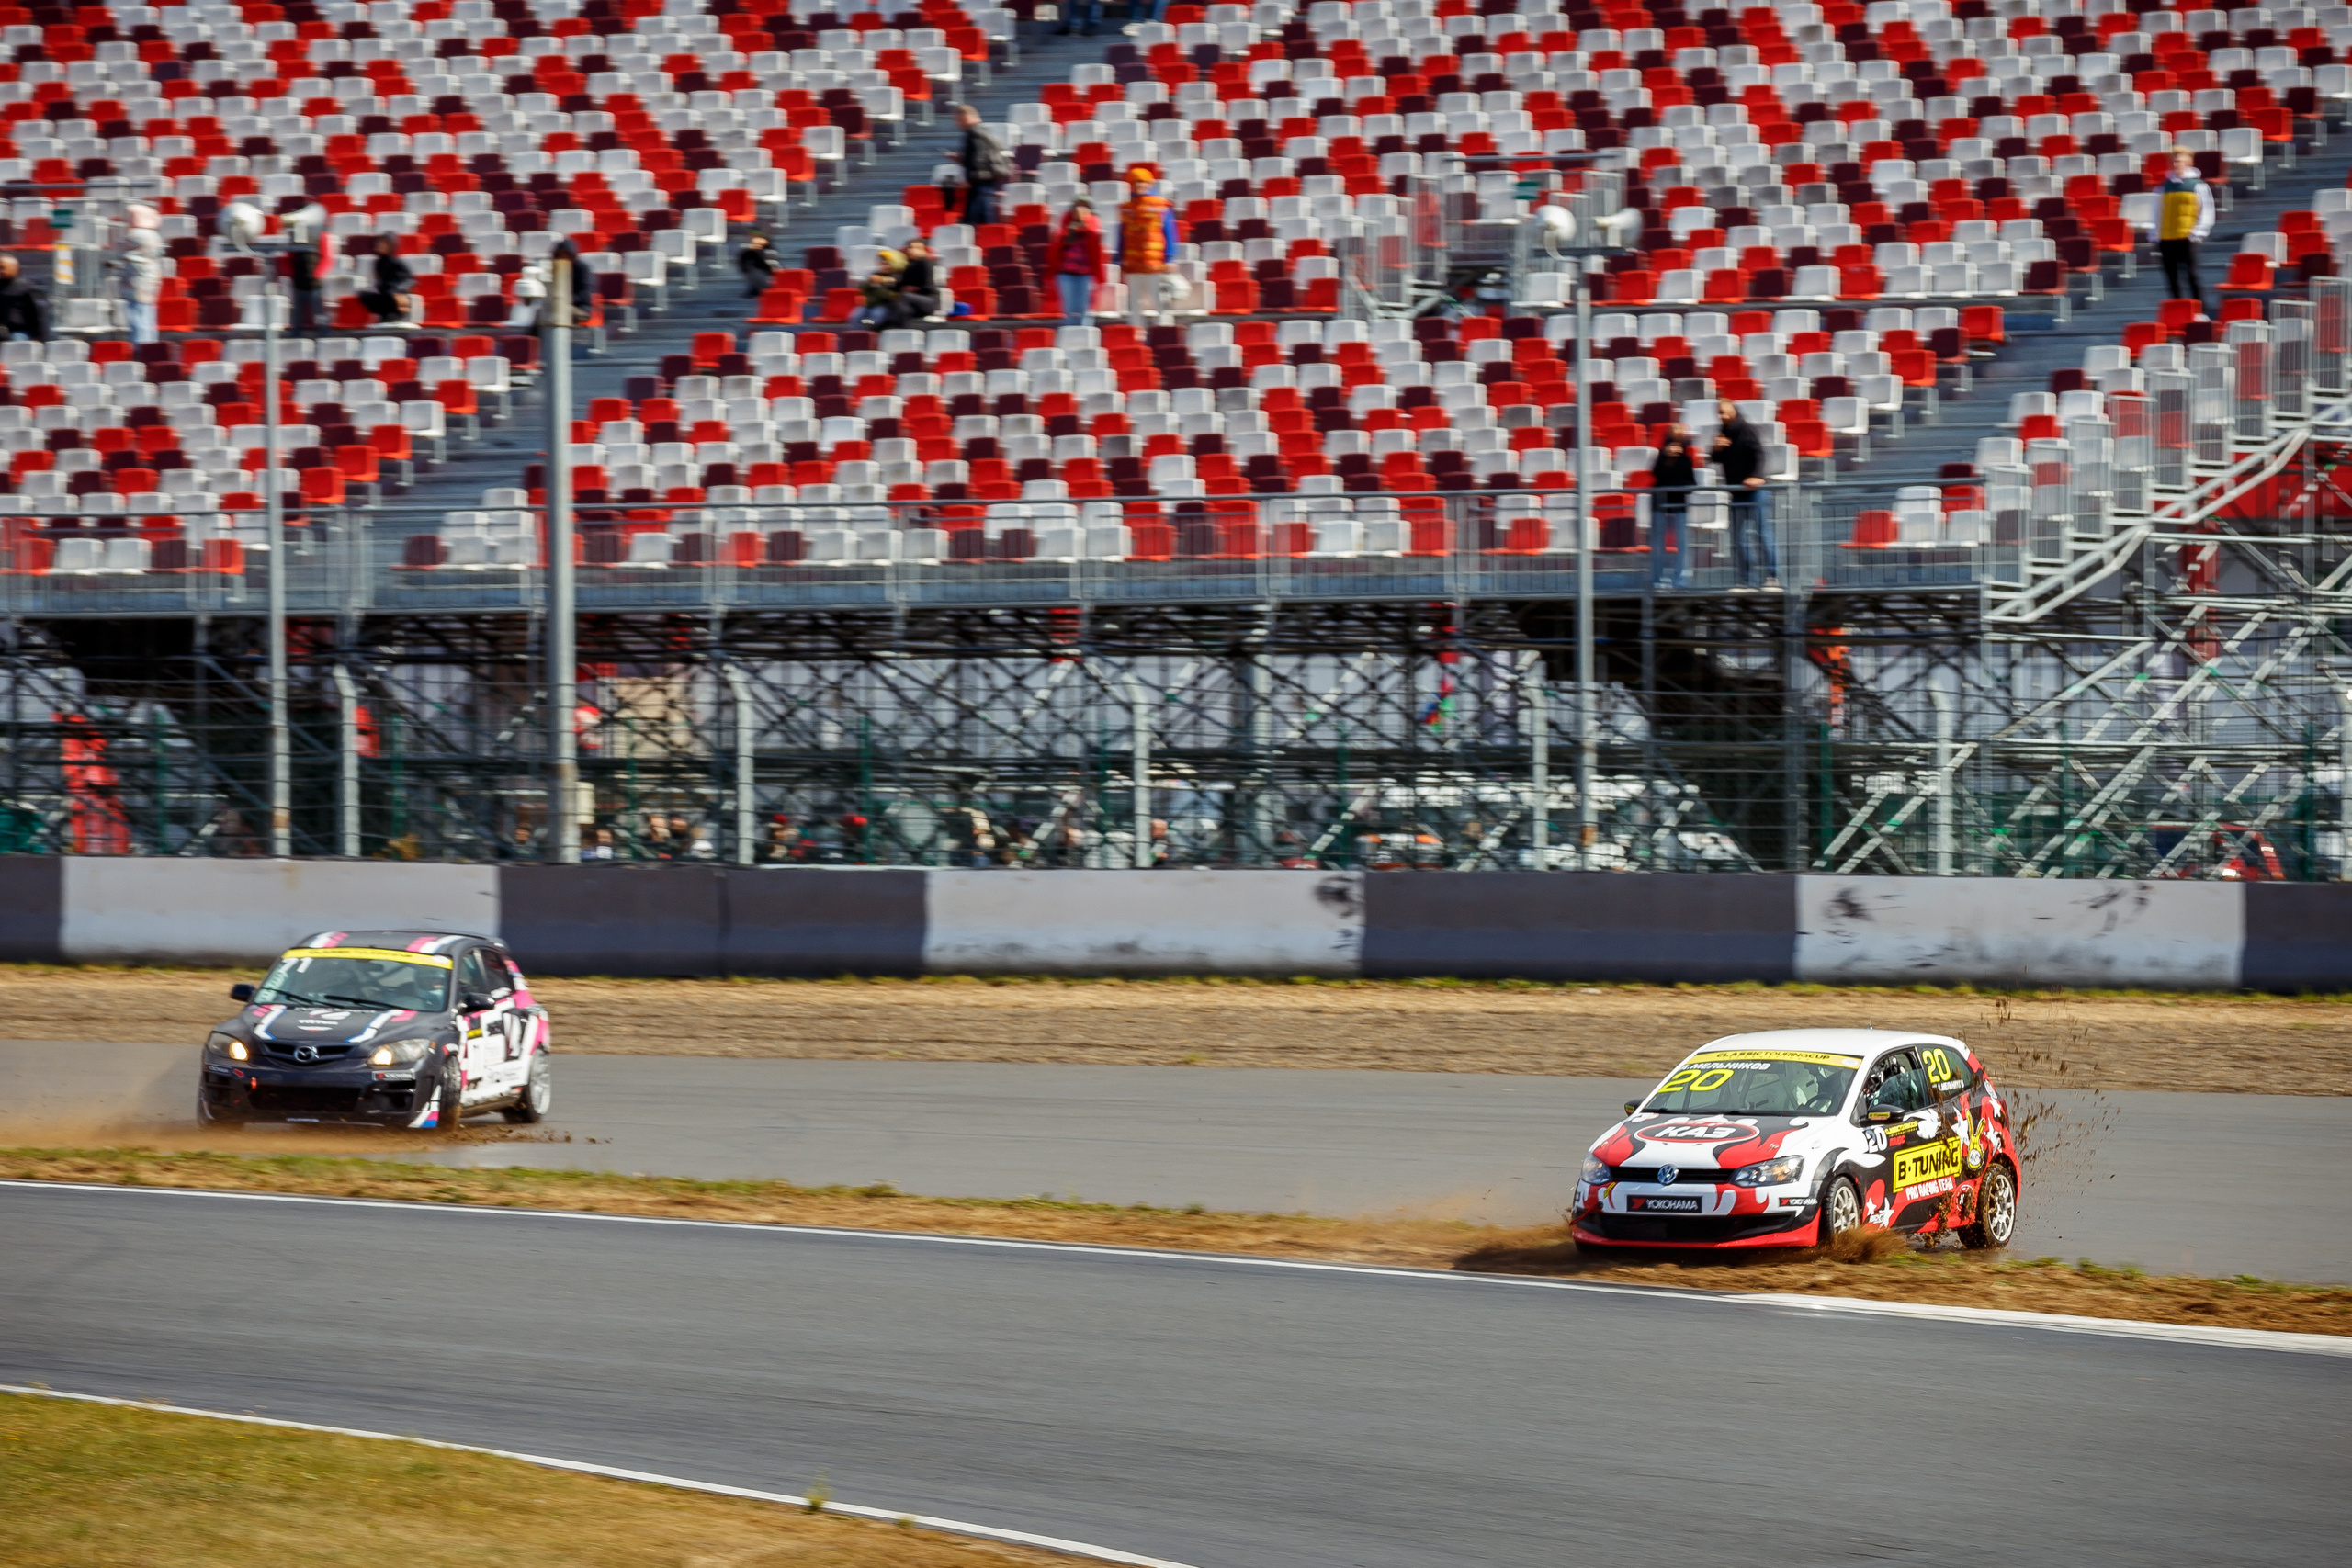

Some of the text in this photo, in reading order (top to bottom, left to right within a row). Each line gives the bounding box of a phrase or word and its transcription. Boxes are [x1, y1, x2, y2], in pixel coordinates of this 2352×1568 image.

[1922, 1048, 1951, 1083] 20
[1657, 1069, 1735, 1093] 20
[1865, 1127, 1888, 1153] 20
[1645, 1199, 1699, 1211] YOKOHAMA
[1905, 1185, 1919, 1201] PRO
